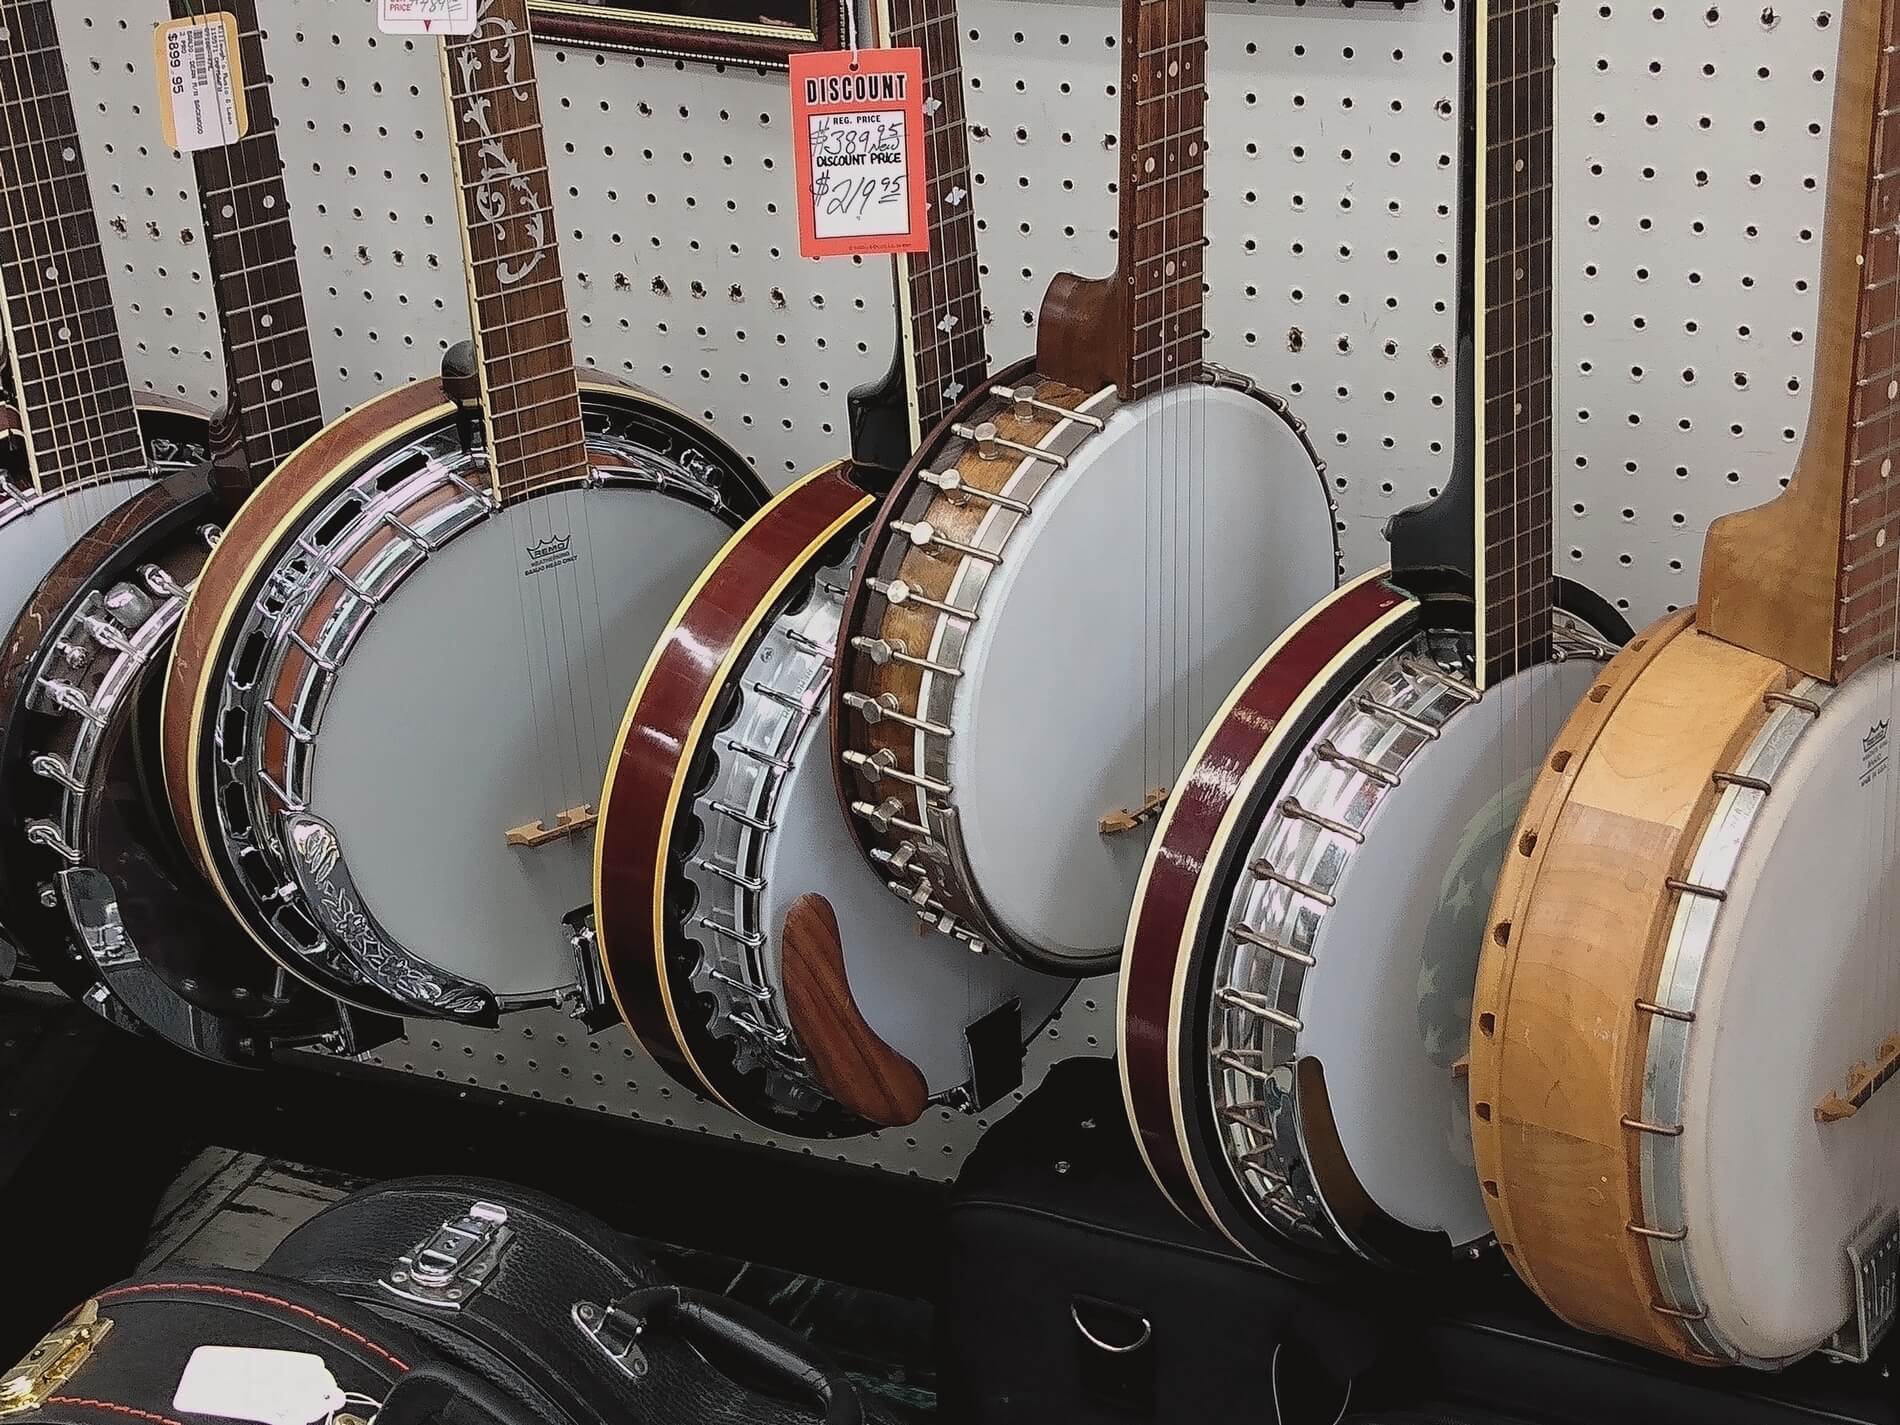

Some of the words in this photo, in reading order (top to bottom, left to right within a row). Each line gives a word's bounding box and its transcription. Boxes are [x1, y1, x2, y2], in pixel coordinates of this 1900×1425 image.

[389, 3, 411, 12] PRICE
[168, 33, 184, 95] $899.95
[806, 74, 906, 104] DISCOUNT
[833, 116, 853, 125] REG.
[856, 114, 881, 124] PRICE
[816, 153, 867, 167] DISCOUNT
[870, 152, 902, 165] PRICE
[534, 543, 566, 557] REMO
